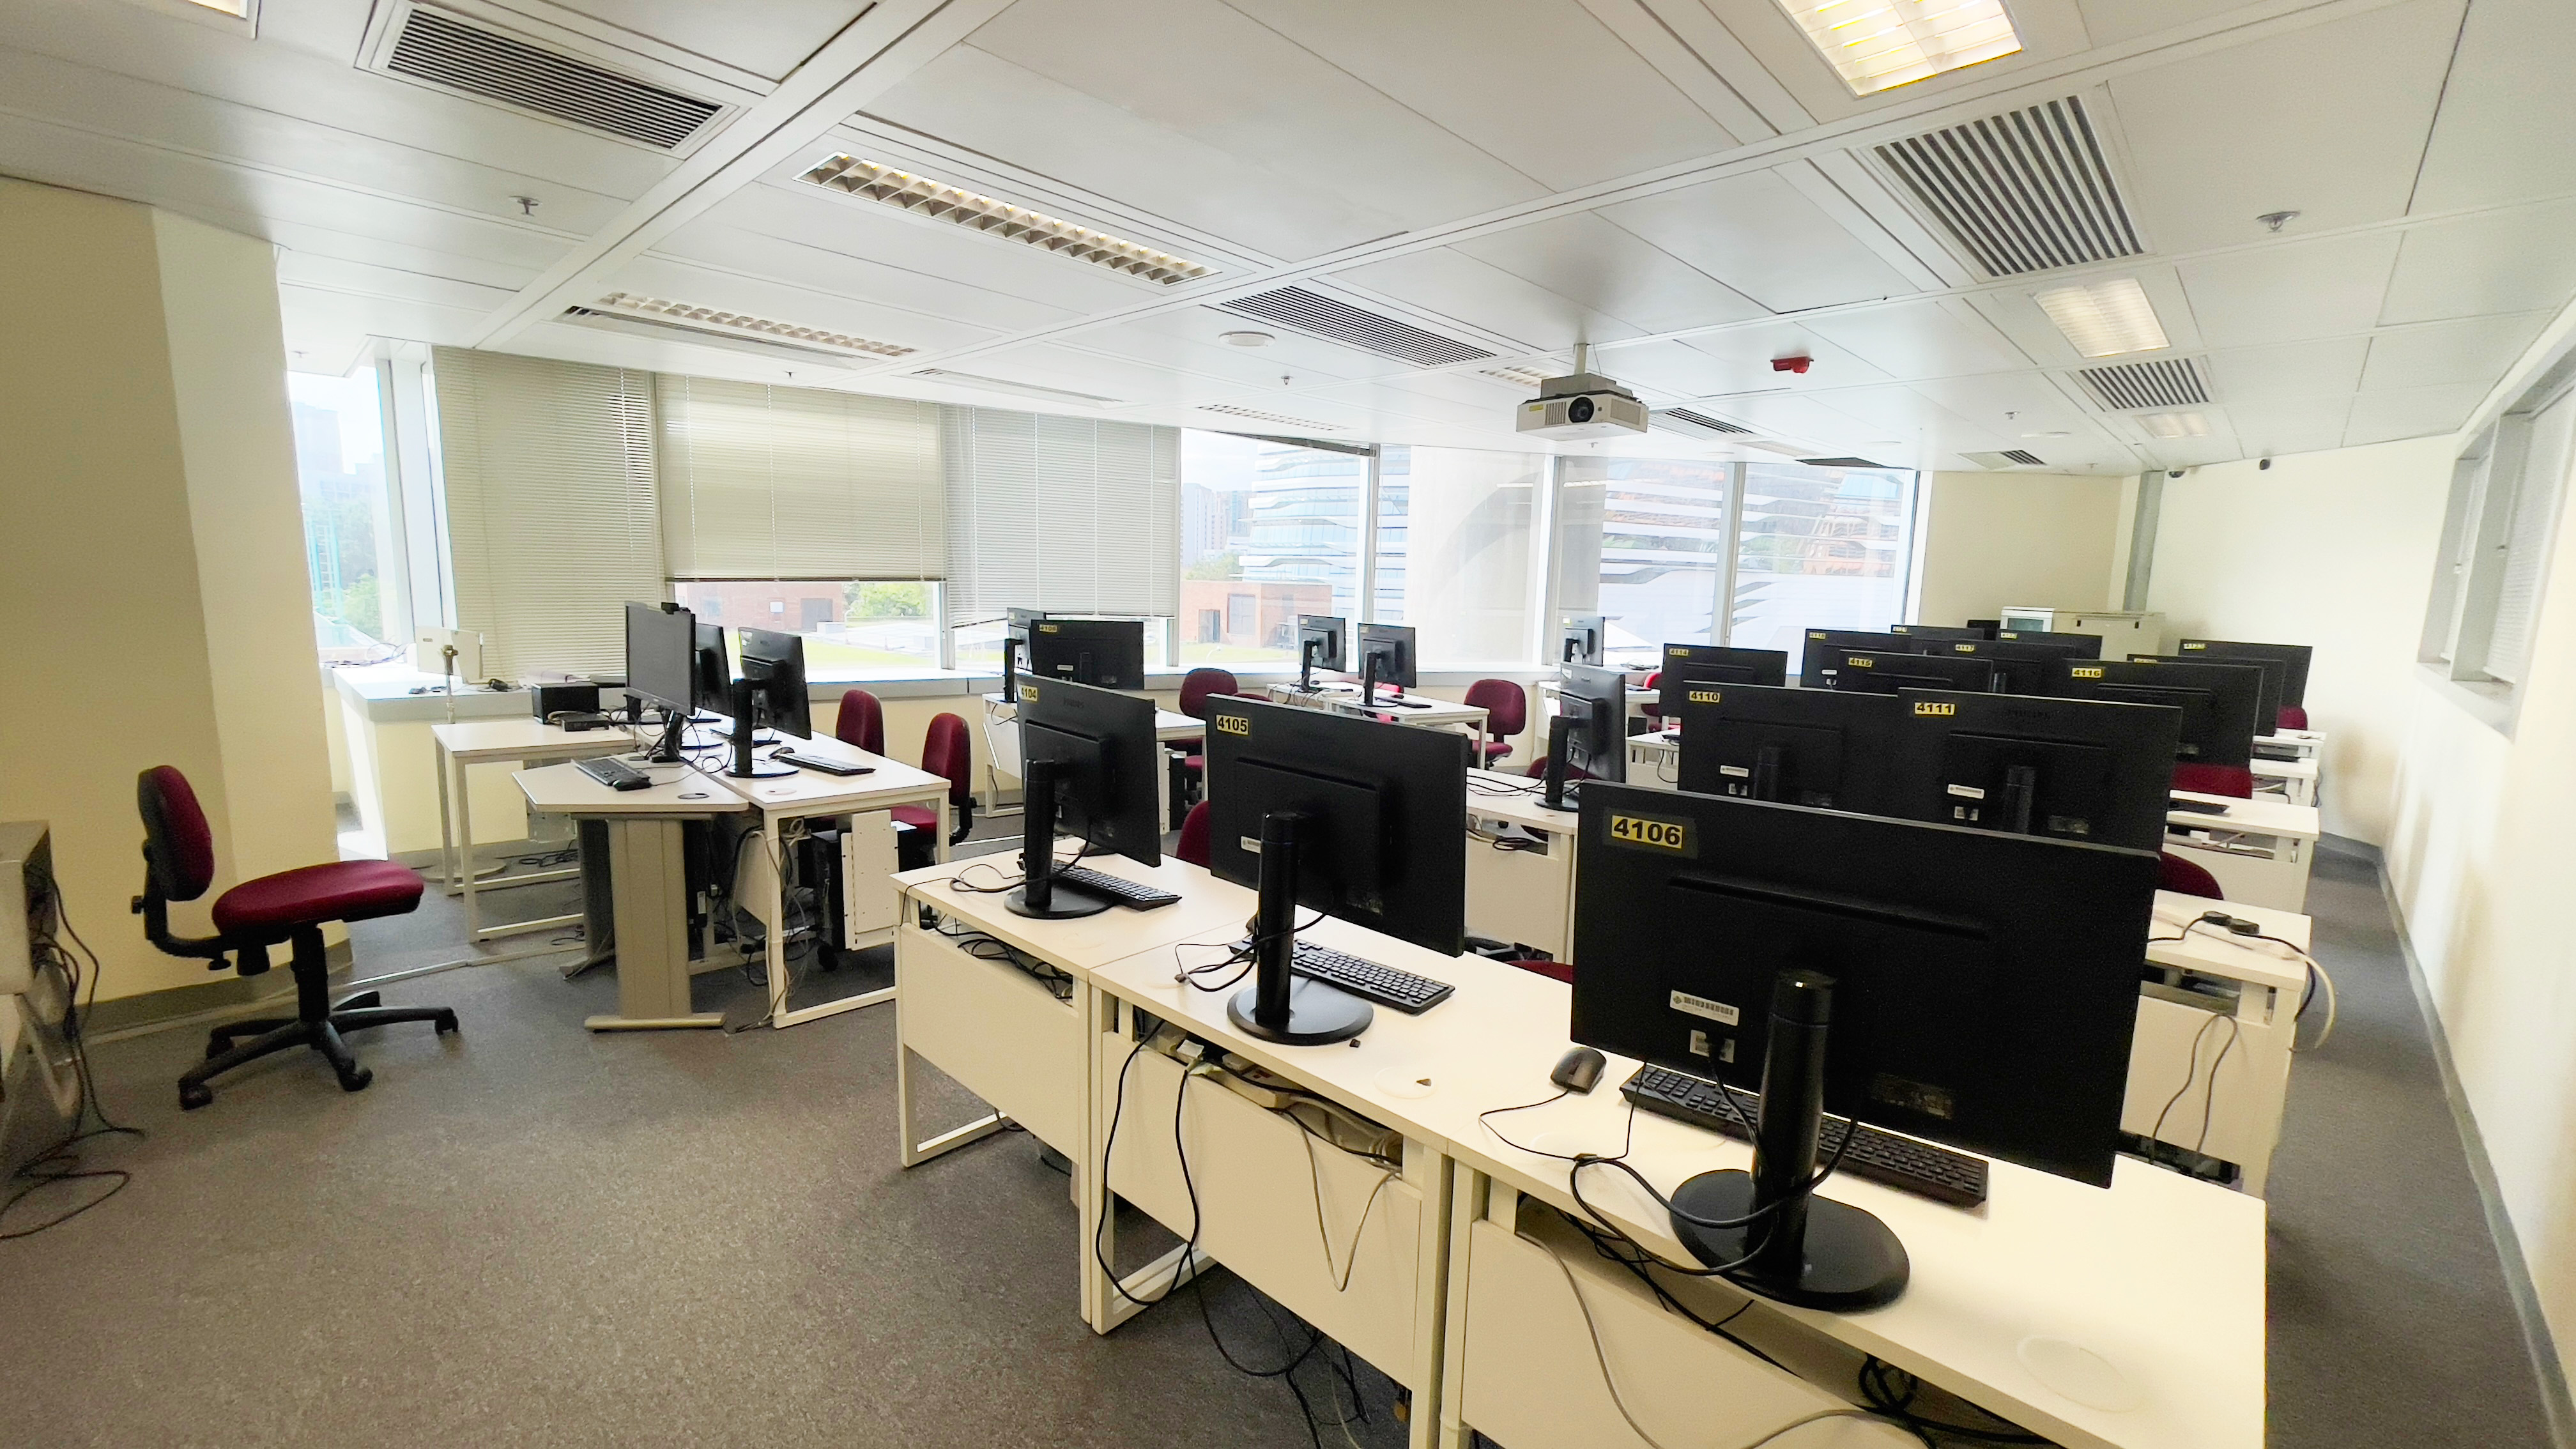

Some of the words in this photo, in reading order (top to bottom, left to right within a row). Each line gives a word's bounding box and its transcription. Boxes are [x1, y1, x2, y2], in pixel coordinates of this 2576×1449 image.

[1850, 658, 1871, 666] 4115
[1690, 692, 1719, 701] 4110
[1917, 703, 1952, 713] 4111
[1218, 716, 1247, 732] 4105
[1613, 818, 1681, 845] 4106
